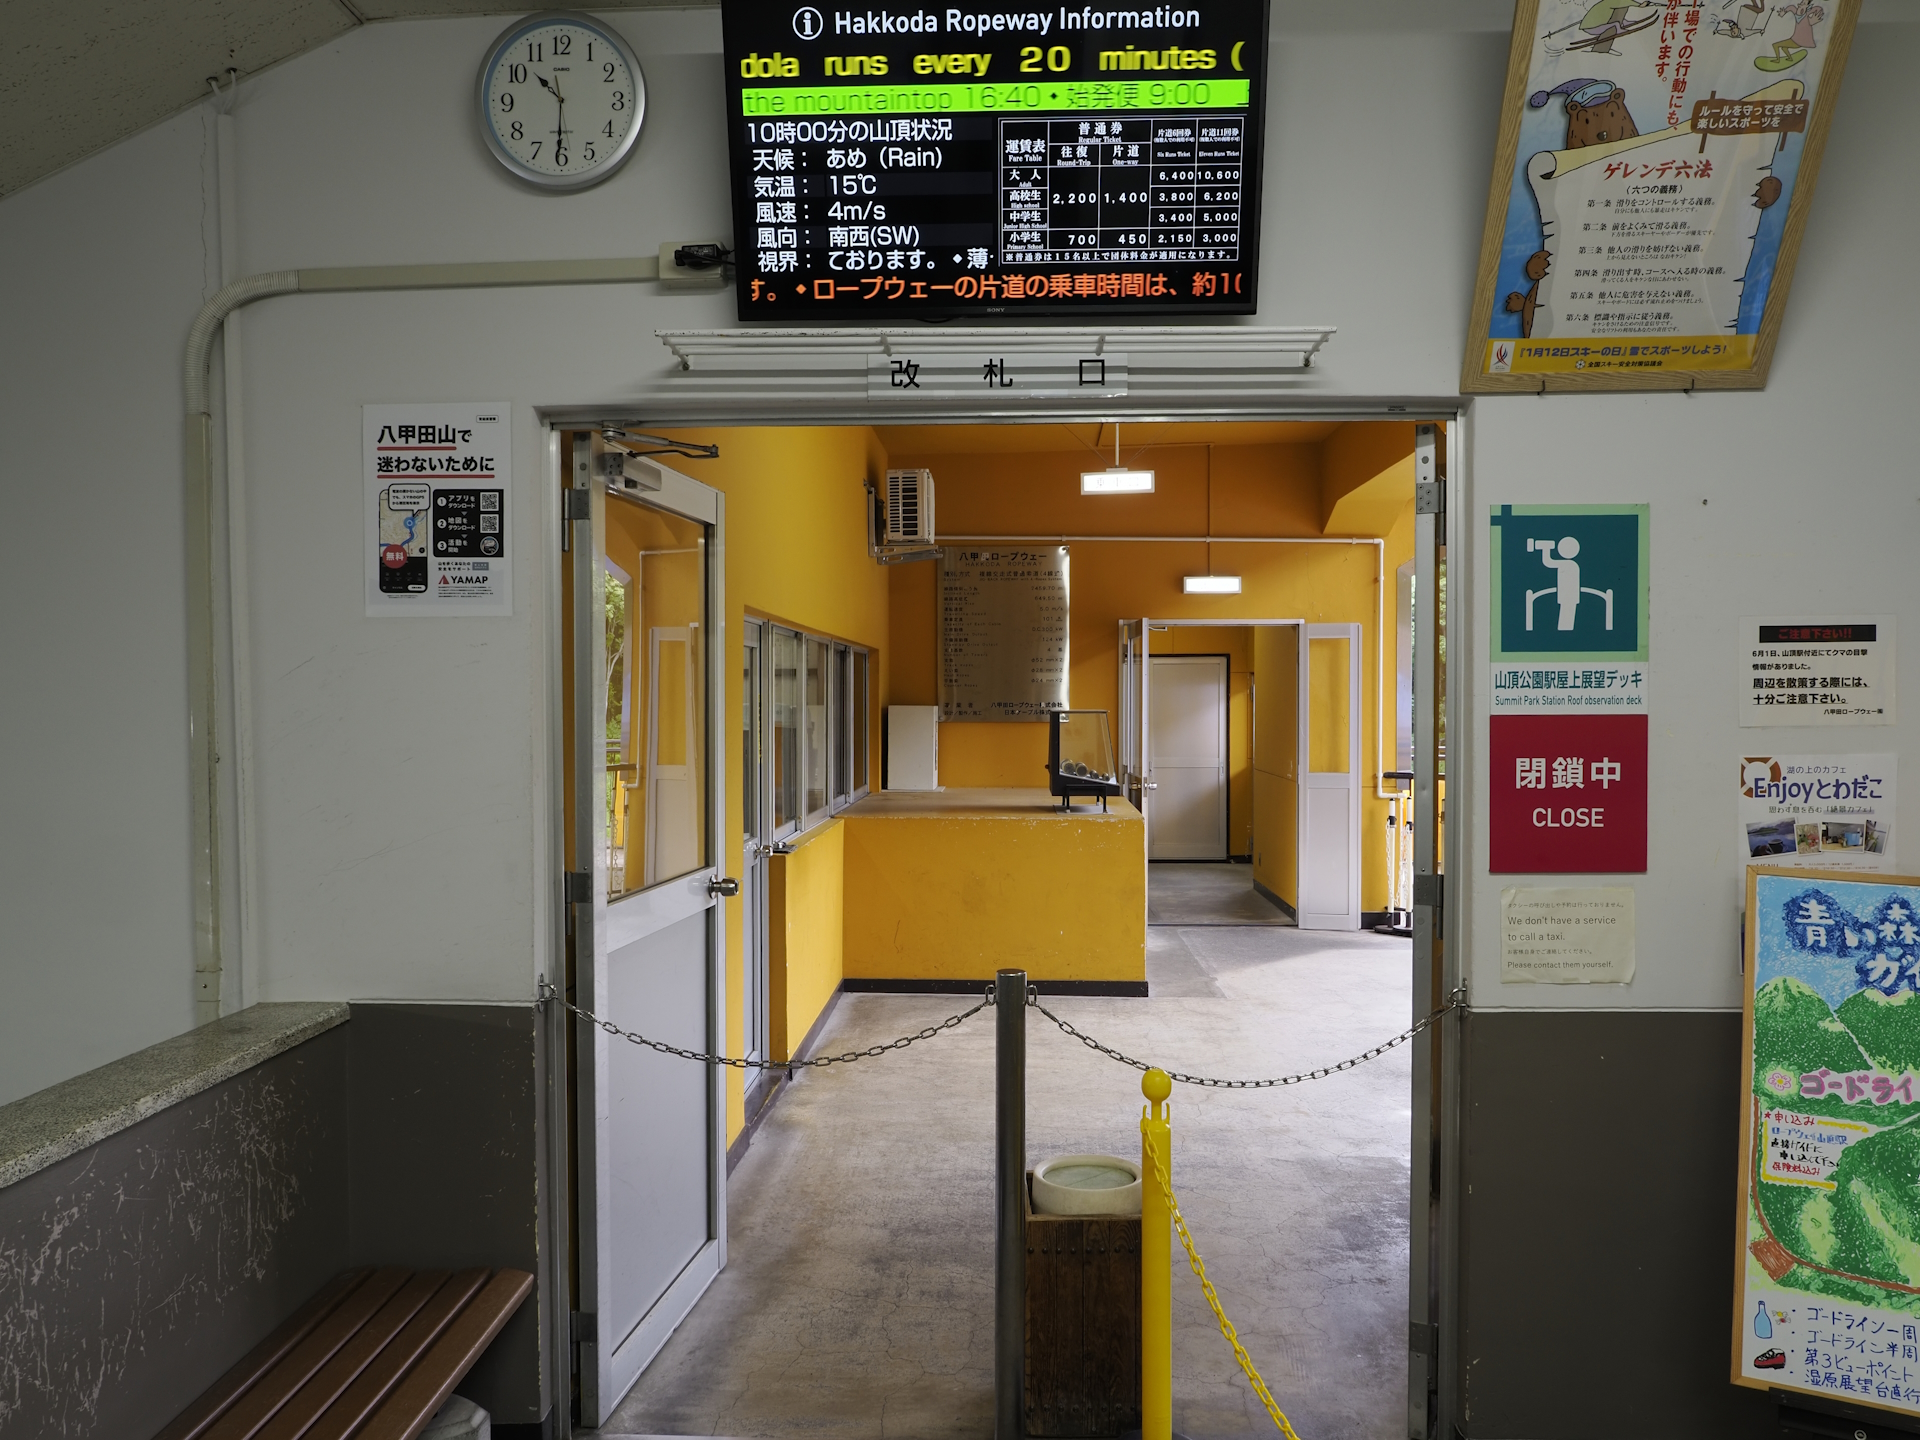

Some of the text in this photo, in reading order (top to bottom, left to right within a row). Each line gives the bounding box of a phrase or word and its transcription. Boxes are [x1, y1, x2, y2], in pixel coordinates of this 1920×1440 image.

[835, 5, 1200, 36] Hakkoda Ropeway Information
[528, 42, 543, 62] 11
[552, 35, 571, 55] 12
[587, 42, 593, 61] 1
[824, 55, 889, 76] runs
[913, 53, 992, 77] every
[1020, 46, 1071, 72] 20
[1099, 45, 1217, 71] minutes
[509, 63, 527, 83] 10
[603, 63, 614, 82] 2
[501, 93, 514, 112] 9
[612, 91, 624, 111] 3
[745, 83, 1211, 113] the mountaintop 16:40 始発便 9:00
[1699, 103, 1804, 117] ルールを守って安全で
[602, 120, 614, 138] 4
[1078, 122, 1123, 136] 普通券
[1697, 115, 1780, 129] 楽しいスポーツを
[511, 121, 523, 140] 8
[748, 118, 953, 144] 10時00分の山頂状況
[1158, 128, 1192, 137] 片道6回券
[1201, 128, 1239, 137] 片道11回券
[531, 142, 542, 160] 7
[584, 142, 594, 160] 5
[1005, 139, 1046, 154] 運賃表
[1060, 145, 1088, 158] 往復
[1113, 144, 1139, 157] 片道
[555, 147, 568, 166] 6
[1008, 154, 1042, 162] Fare Table
[1112, 158, 1139, 166] One-way
[1009, 169, 1041, 180] 大人
[1159, 170, 1239, 181] 6,400 10,600
[1604, 159, 1714, 181] ゲレンデ六法
[1009, 190, 1041, 201] 高校生
[1053, 192, 1238, 204] 2,200 1,400 3,800 6,200
[1587, 197, 1715, 208] 第一条 滑りをコントロールする義務。
[827, 201, 886, 220] 4m/s
[1009, 211, 1041, 222] 中学生
[1158, 213, 1238, 223] 3,400 5,000
[1582, 221, 1691, 231] 第二条 前をよくみて滑る義務。
[829, 225, 920, 247] 南西(SW)
[1009, 231, 1041, 243] 小学生
[1068, 234, 1237, 245] 700 450 2,150 3,000
[1578, 244, 1704, 254] 第三条 他人の滑りを妨げない義務。
[828, 249, 935, 271] ております。
[1574, 266, 1726, 277] 第四条 滑り出す時、コースへ入る時の義務。
[1569, 290, 1695, 299] 第五条 他人に危害を与えない義務。
[1565, 312, 1674, 322] 第六条 標識や指示に従う義務。
[1587, 360, 1663, 368] 全国スキー安全対策協議会
[891, 359, 1106, 389] 改札口
[377, 424, 473, 444] 八甲田山で
[377, 456, 495, 473] 迷わないために
[386, 552, 404, 561] 無料
[959, 551, 1047, 561] 八甲田ロープウェー
[450, 575, 488, 584] YAMAP
[1778, 628, 1852, 639] ご注意下さい!!
[1752, 648, 1868, 657] 6月1日、山頂駅付近にてクマの目撃
[1752, 663, 1811, 671] 情報がありました。
[1495, 670, 1642, 690] 山頂公園駅屋上展望デッキ
[1753, 677, 1869, 688] 周辺を散策する際には、
[1495, 695, 1642, 706] Summit Park Station Roof observation deck
[1753, 693, 1846, 704] 十分ご注意下さい。
[1515, 757, 1621, 789] 閉鎖中
[1786, 766, 1847, 775] 湖の上のカフェ
[1533, 808, 1605, 827] CLOSE
[1507, 916, 1522, 925] We
[1525, 916, 1548, 925] don't
[1550, 916, 1572, 925] have
[1583, 915, 1616, 925] service
[1508, 933, 1517, 941] to
[1520, 932, 1536, 941] call
[1547, 932, 1566, 941] taxi.
[1507, 960, 1614, 970] Please contact them yourself.
[1800, 1069, 1914, 1104] ゴードライ
[1807, 1307, 1917, 1344] ゴードライン一周
[1807, 1330, 1918, 1363] ゴードライン半周
[1805, 1347, 1914, 1382] 第3ビューポイント
[1804, 1369, 1920, 1404] 湿原展望台直行
